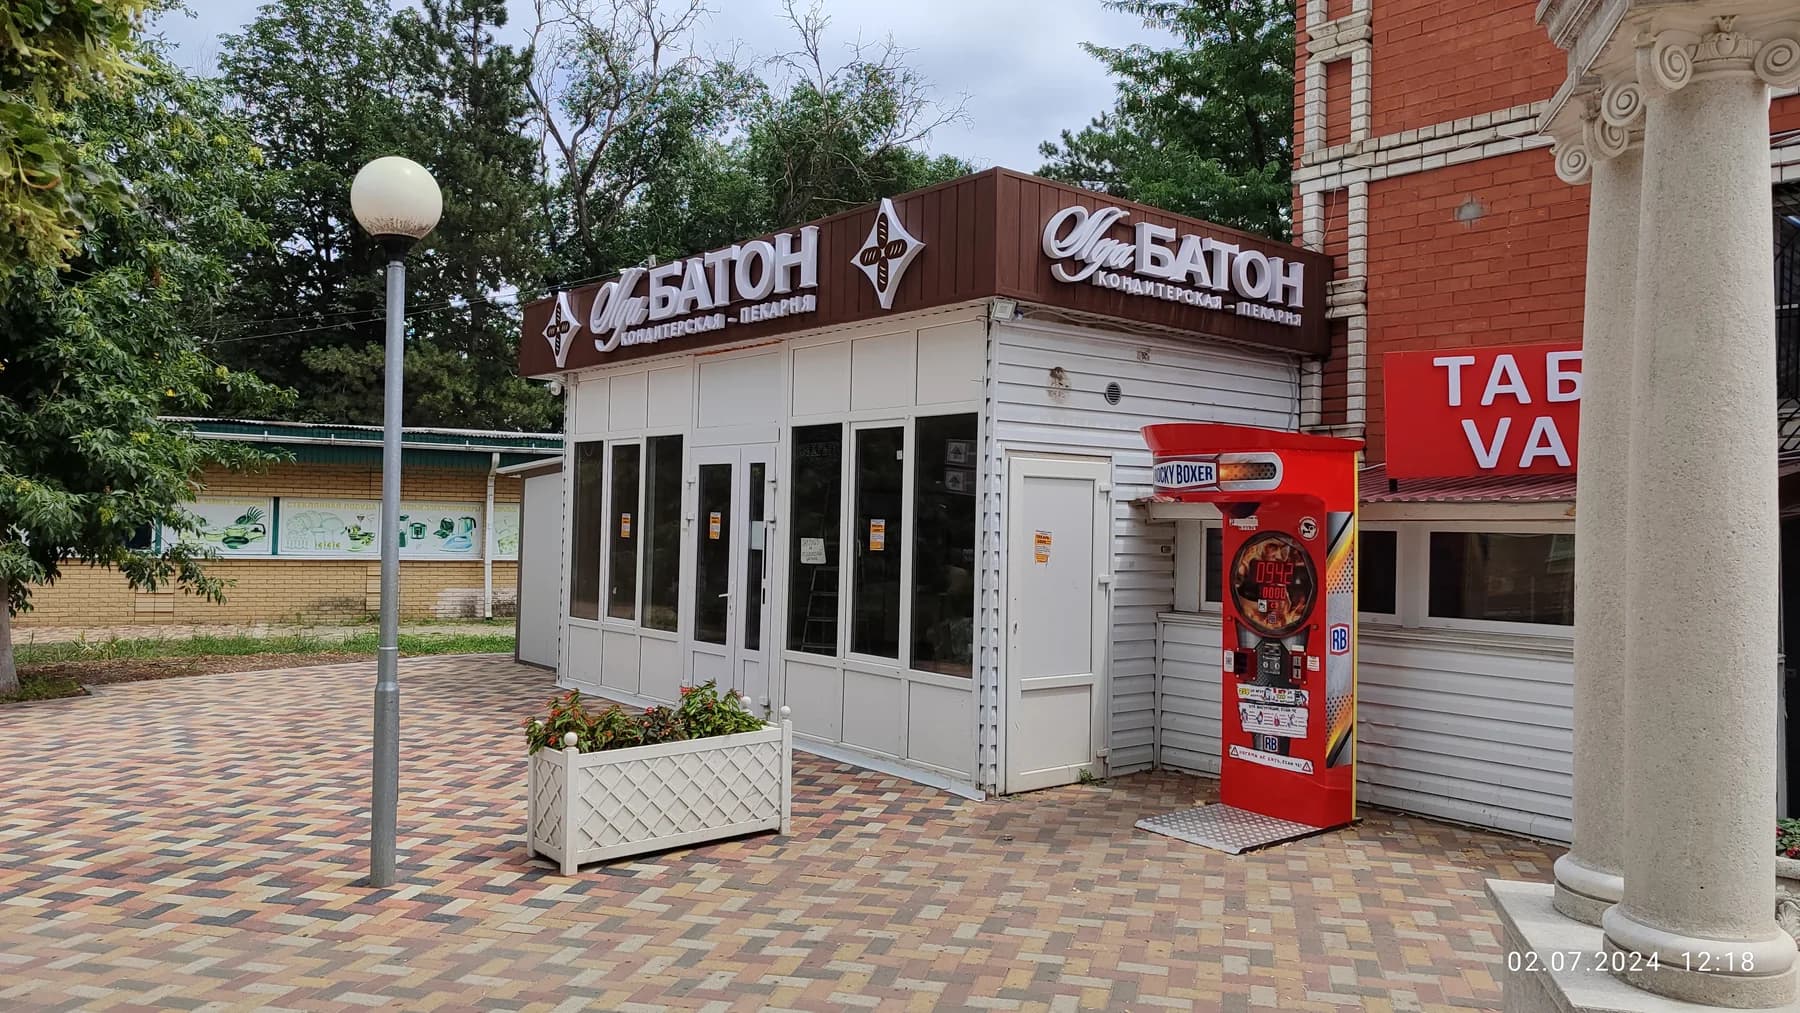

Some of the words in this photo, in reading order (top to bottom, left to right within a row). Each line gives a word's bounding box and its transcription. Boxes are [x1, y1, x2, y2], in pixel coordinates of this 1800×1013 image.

[649, 225, 820, 321] БАТОН
[1134, 222, 1304, 308] БАТОН
[1092, 271, 1222, 310] КОНДИТЕРСКАЯ
[1236, 301, 1302, 327] ПЕКАРНЯ
[620, 314, 725, 347] КОНДИТЕРСКАЯ
[740, 295, 817, 324] ПЕКАРНЯ
[1176, 464, 1213, 484] BOXER
[1256, 562, 1294, 585] 0942
[1332, 628, 1347, 651] RB
[1265, 737, 1277, 751] RB
